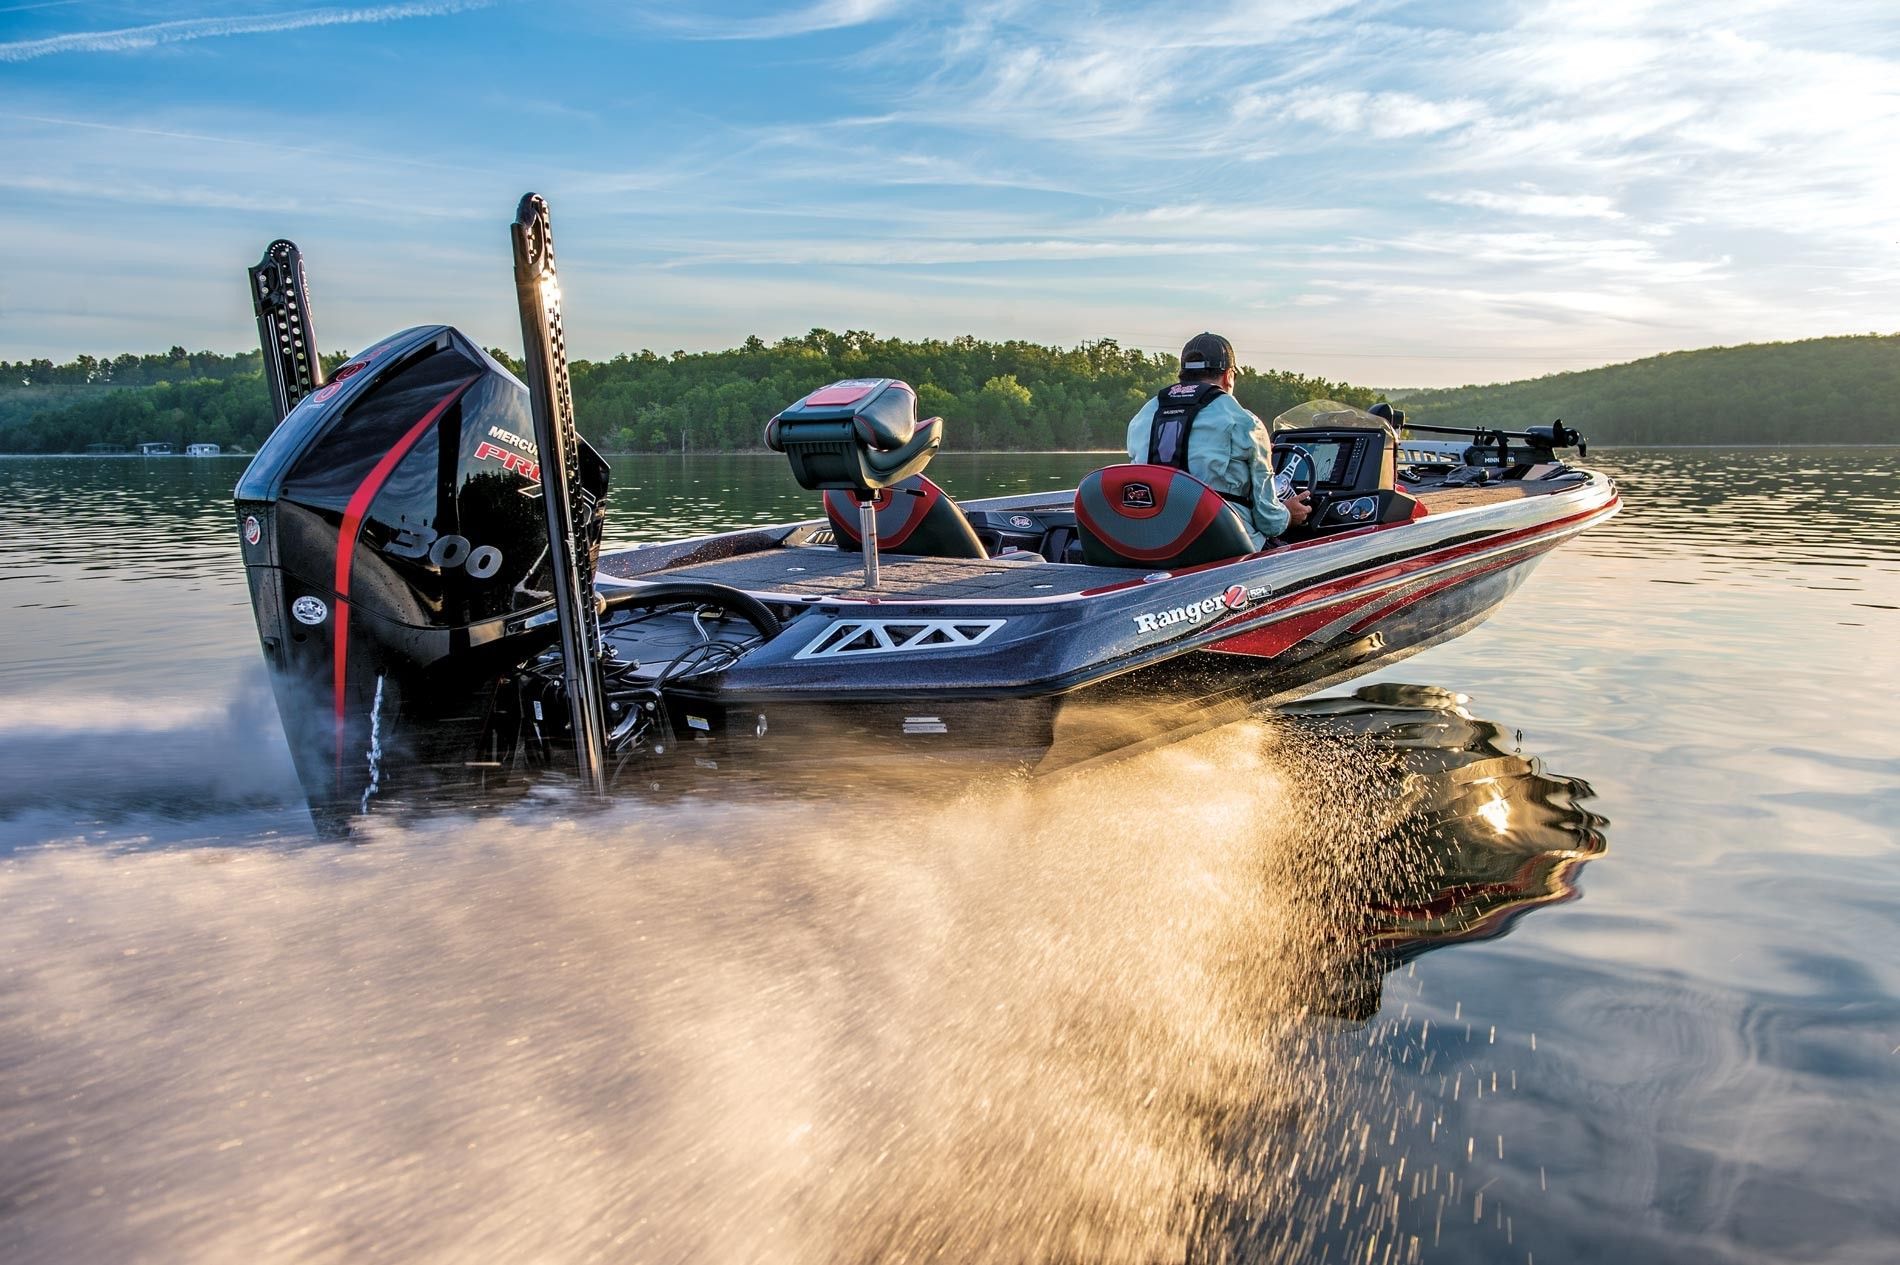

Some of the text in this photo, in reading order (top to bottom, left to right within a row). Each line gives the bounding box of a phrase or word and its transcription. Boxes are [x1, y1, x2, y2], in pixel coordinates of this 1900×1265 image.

[487, 425, 539, 457] MERCU
[382, 526, 503, 579] 300
[1133, 595, 1226, 634] Ranger
